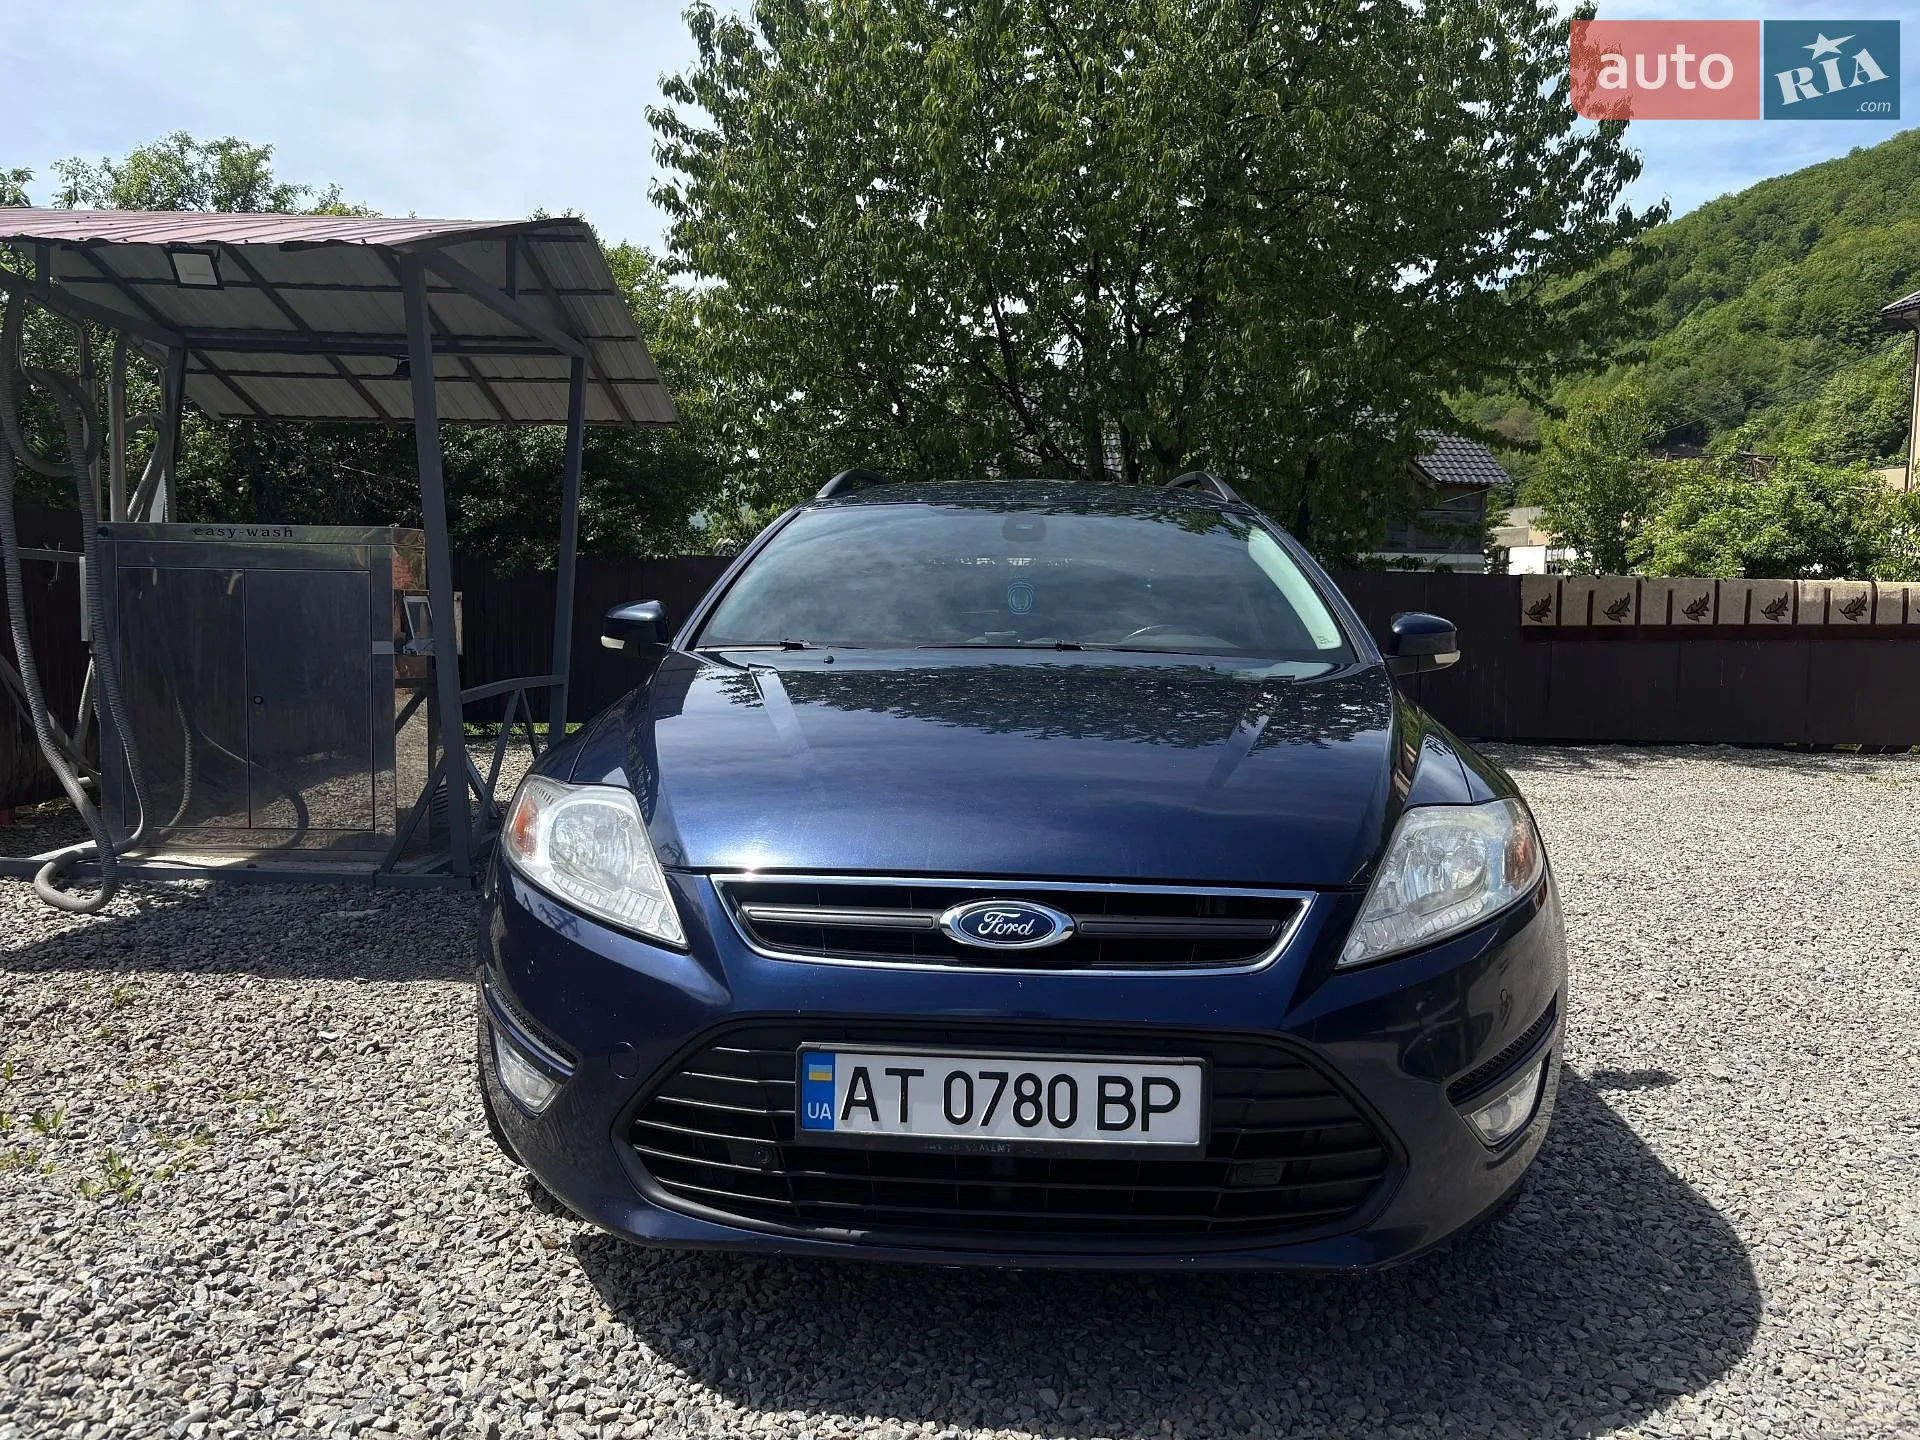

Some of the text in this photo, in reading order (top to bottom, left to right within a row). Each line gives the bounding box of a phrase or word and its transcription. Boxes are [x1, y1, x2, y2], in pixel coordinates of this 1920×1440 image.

[193, 526, 294, 538] easy-wash
[977, 911, 1036, 936] Ford
[840, 1066, 1182, 1132] AT 0780 BP
[807, 1101, 832, 1121] UA
